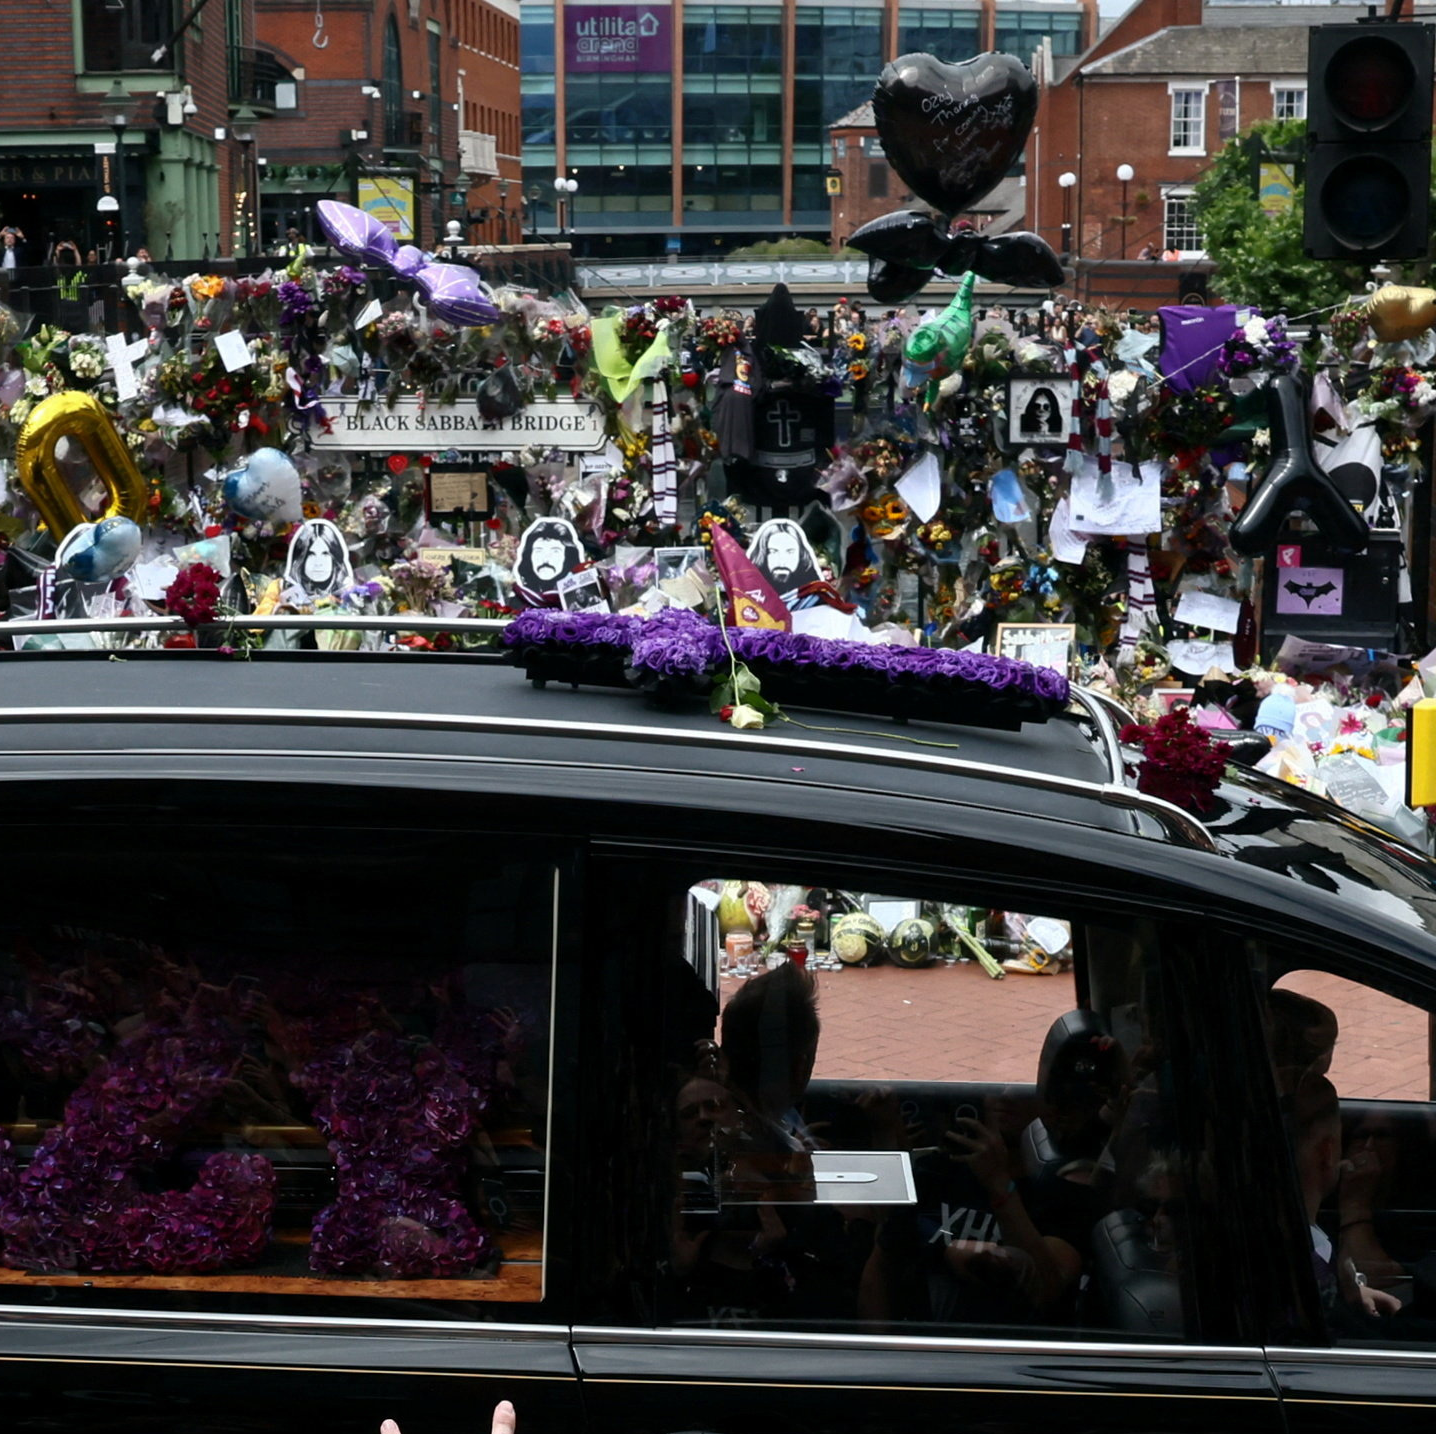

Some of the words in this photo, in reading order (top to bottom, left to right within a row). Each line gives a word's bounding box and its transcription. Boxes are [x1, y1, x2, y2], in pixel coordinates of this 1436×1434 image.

[576, 16, 637, 36] utilita
[576, 37, 639, 53] arena
[54, 166, 98, 182] PIA
[346, 415, 409, 431] BLACK
[510, 415, 586, 431] BRIDGE
